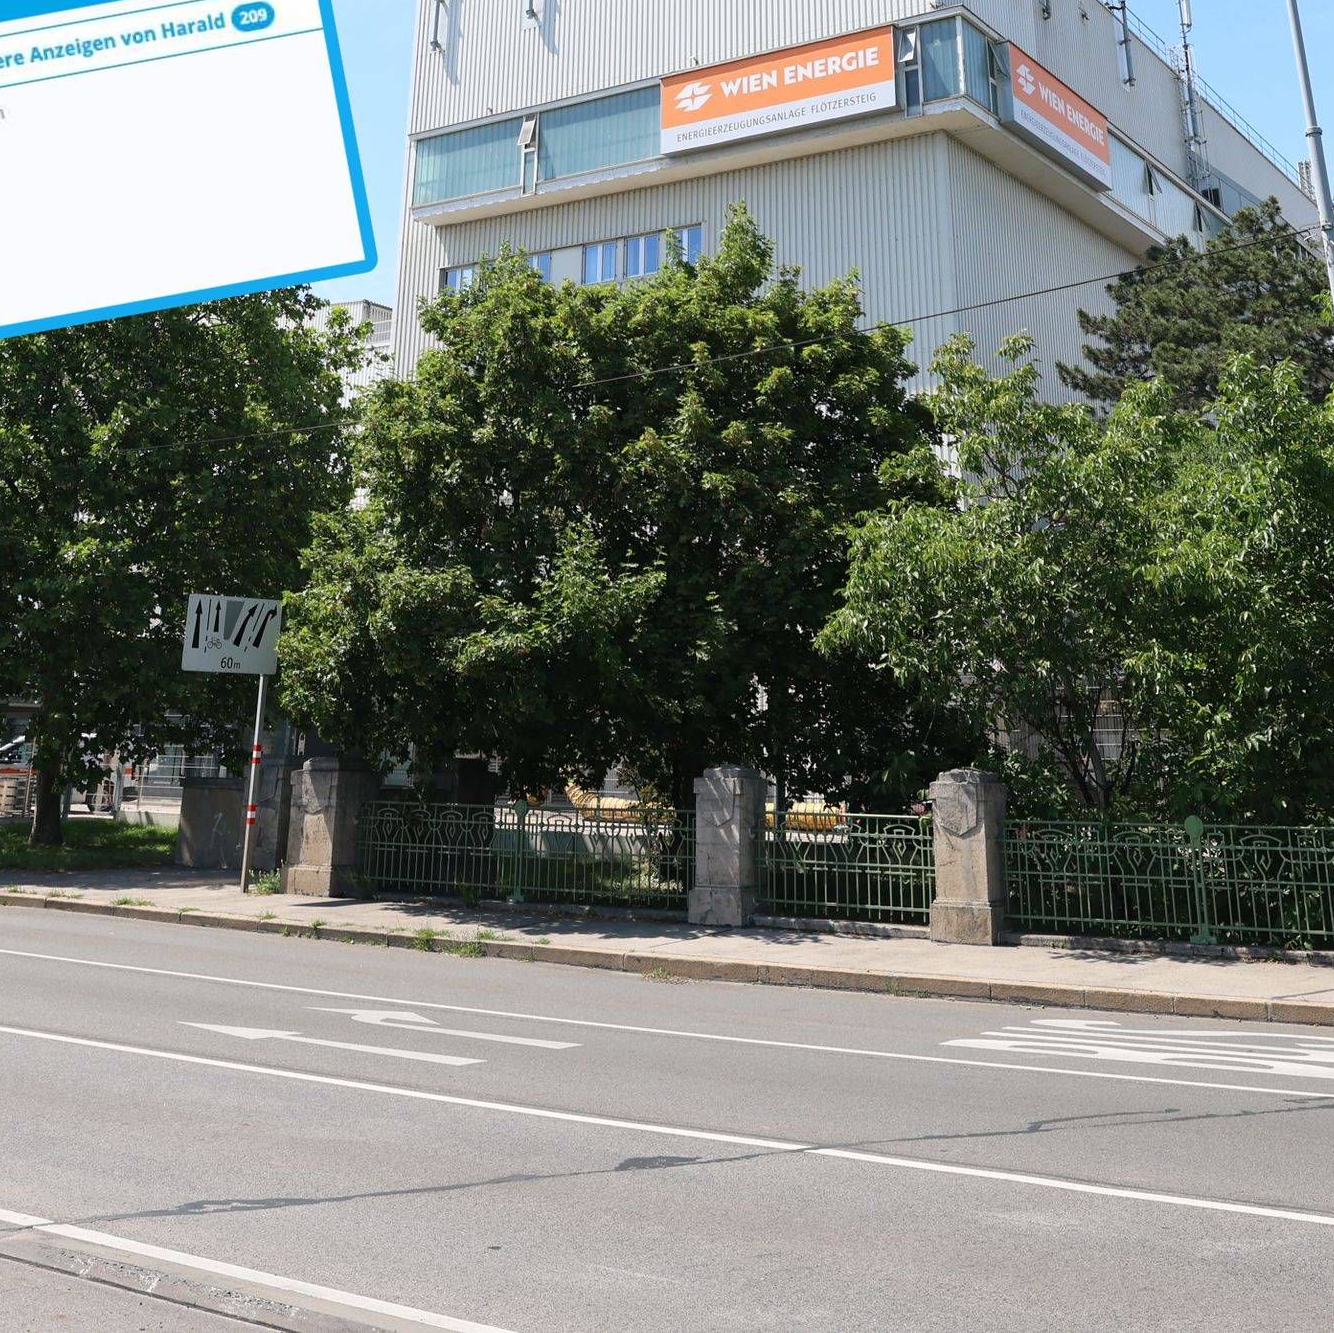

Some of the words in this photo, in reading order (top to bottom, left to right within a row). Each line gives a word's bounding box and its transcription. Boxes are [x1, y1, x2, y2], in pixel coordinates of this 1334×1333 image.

[720, 69, 778, 98] WIEN
[784, 46, 879, 85] ENERGIE
[676, 108, 806, 142] ENERGIEERZEUGUNGSANLAGE
[810, 91, 877, 114] FLÖTZERSTEIG
[1038, 81, 1066, 117] WIEN
[1067, 104, 1105, 147] ENERGIE
